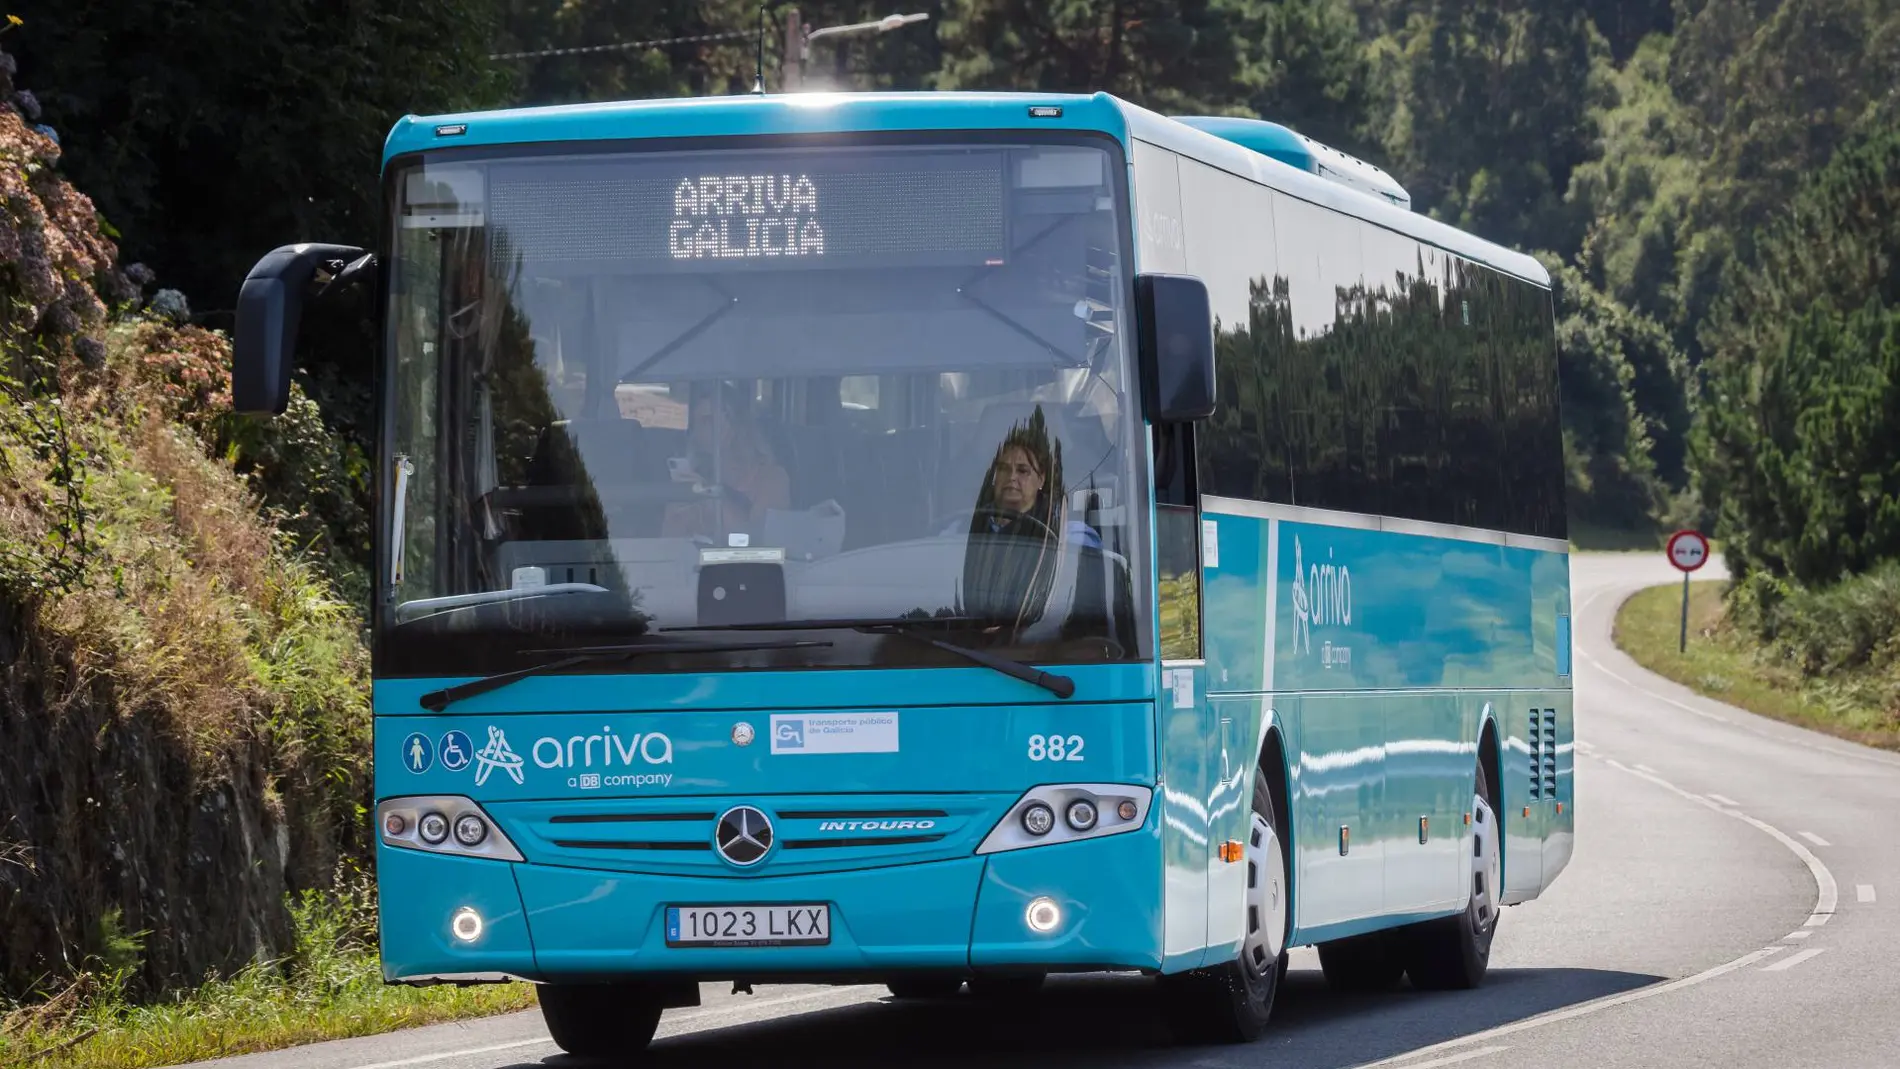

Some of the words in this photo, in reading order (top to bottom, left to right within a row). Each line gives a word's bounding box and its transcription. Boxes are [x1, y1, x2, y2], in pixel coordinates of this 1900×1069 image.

[675, 174, 816, 216] ARRIVA
[670, 217, 824, 258] GALICIA
[1310, 546, 1351, 625] arriva
[532, 725, 673, 769] arriva
[1028, 734, 1085, 761] 882
[567, 777, 577, 788] a
[581, 775, 600, 788] DB
[604, 773, 673, 789] company
[819, 820, 936, 831] INTOURO
[689, 911, 757, 938] 1023
[768, 909, 823, 936] LKX
